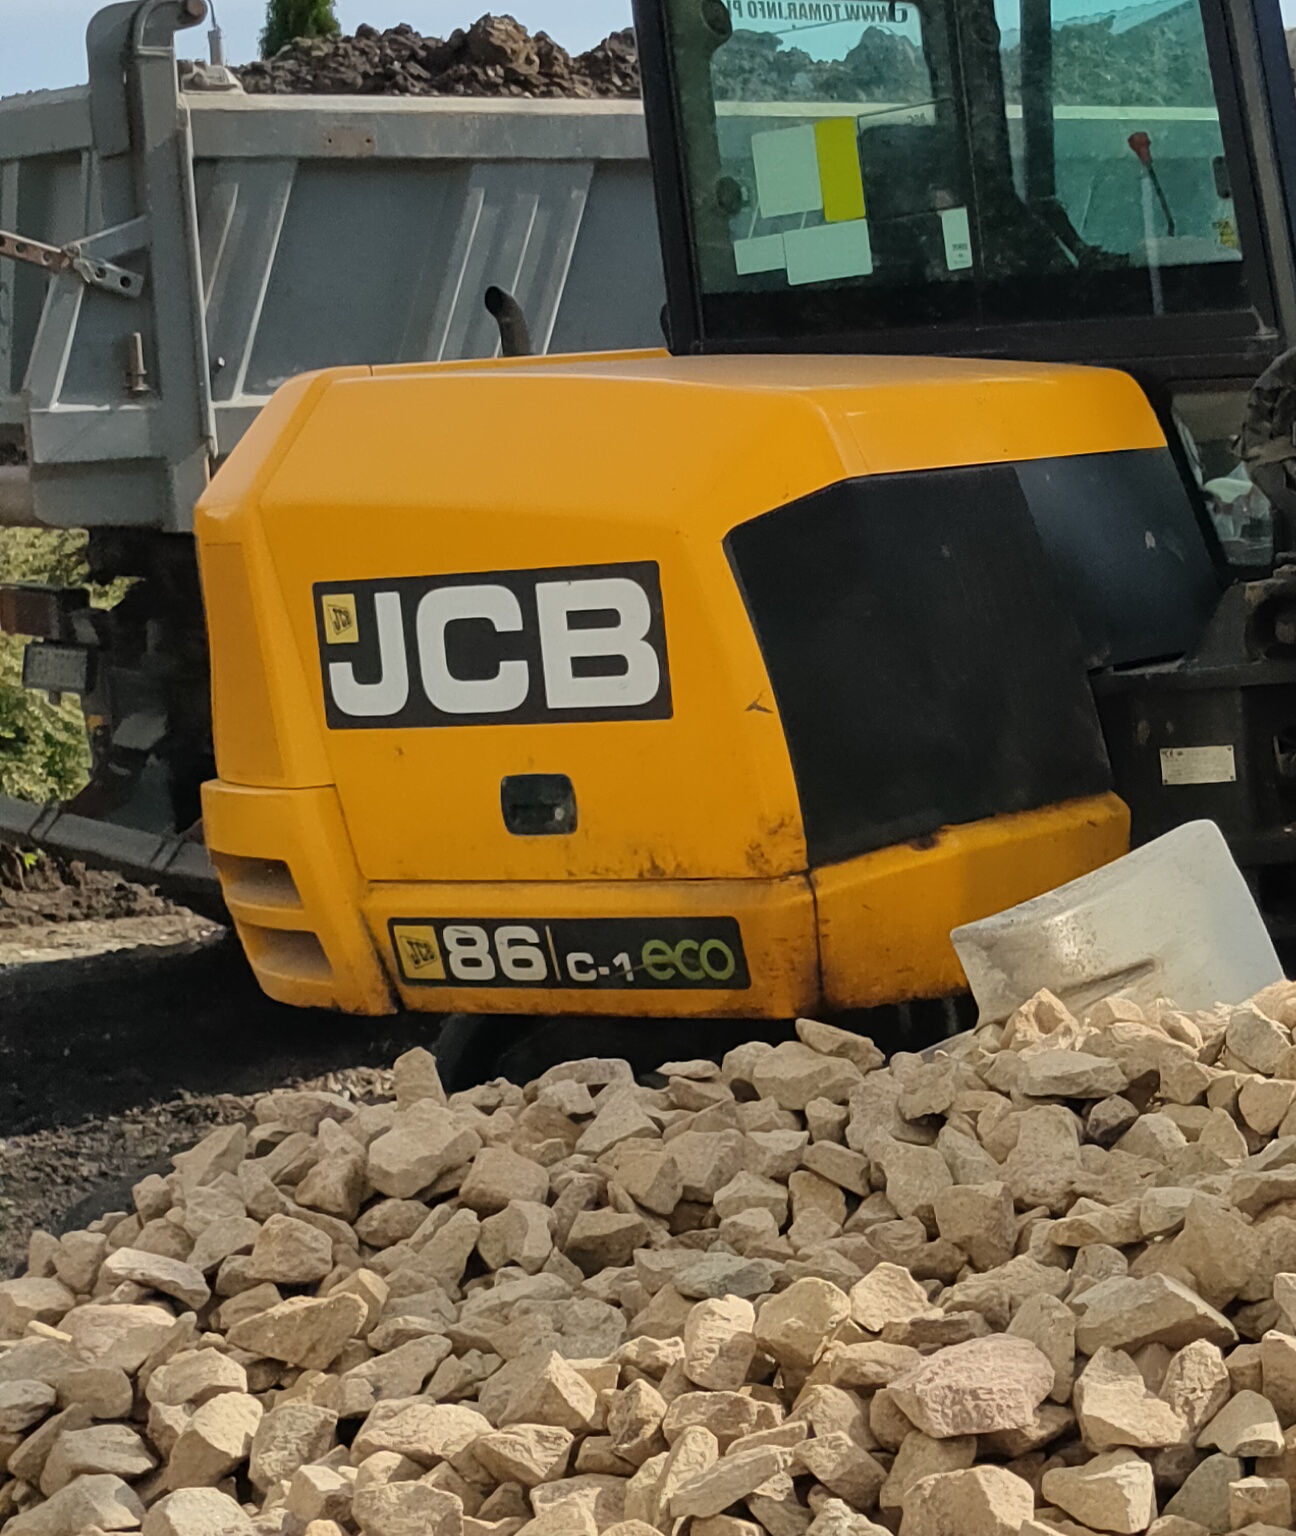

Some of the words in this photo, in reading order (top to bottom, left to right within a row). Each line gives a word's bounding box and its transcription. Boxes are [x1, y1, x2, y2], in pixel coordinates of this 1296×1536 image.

[329, 577, 660, 717] JCB
[442, 925, 547, 981] 86
[642, 938, 736, 981] eco
